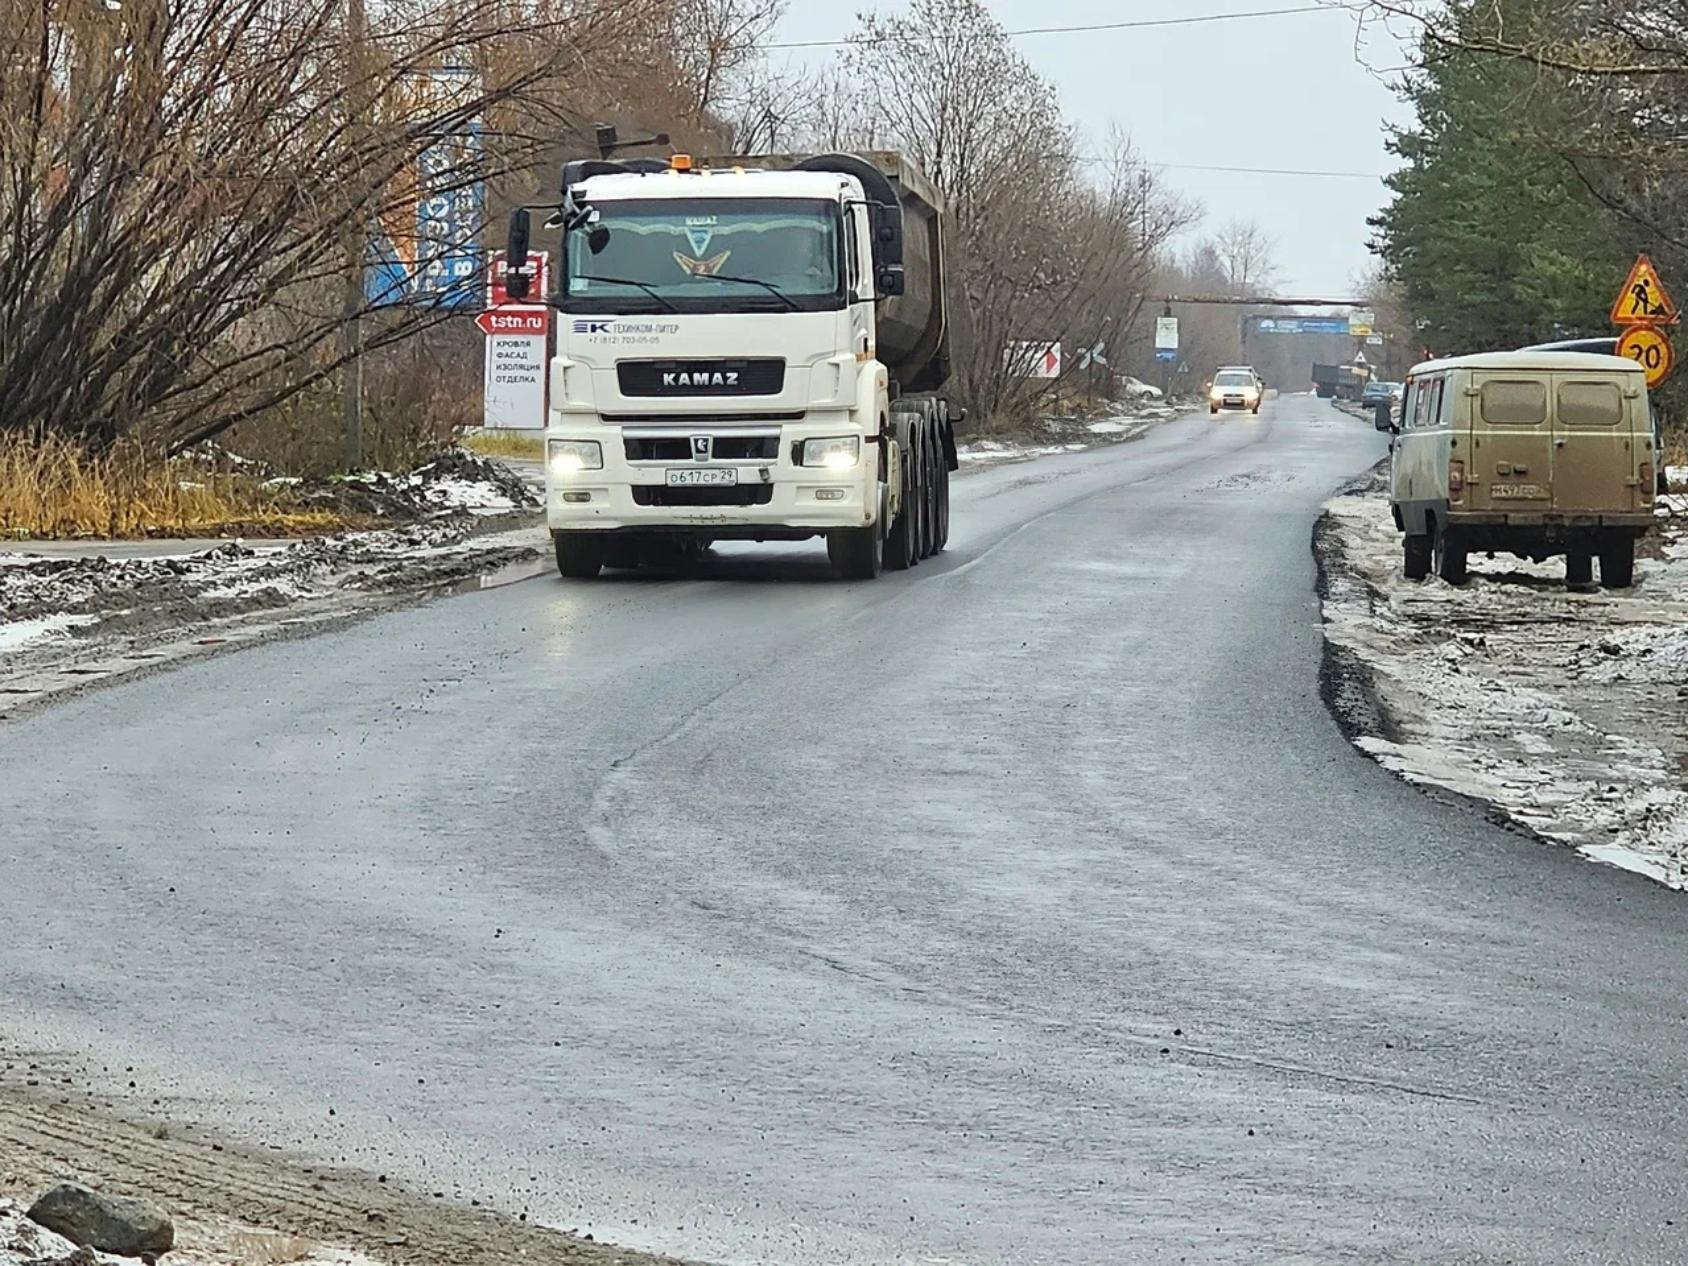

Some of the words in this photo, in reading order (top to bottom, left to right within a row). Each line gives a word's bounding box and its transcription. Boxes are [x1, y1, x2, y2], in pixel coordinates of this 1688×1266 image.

[490, 315, 542, 328] tstn.ru
[496, 340, 531, 348] КРОВЛЯ
[496, 351, 528, 360] ФАСАД
[1629, 343, 1661, 369] 20
[496, 363, 541, 371] ИЗОЛЯЦИЯ
[495, 375, 536, 383] ОТДЕЛКА
[663, 372, 739, 386] KAMAZ
